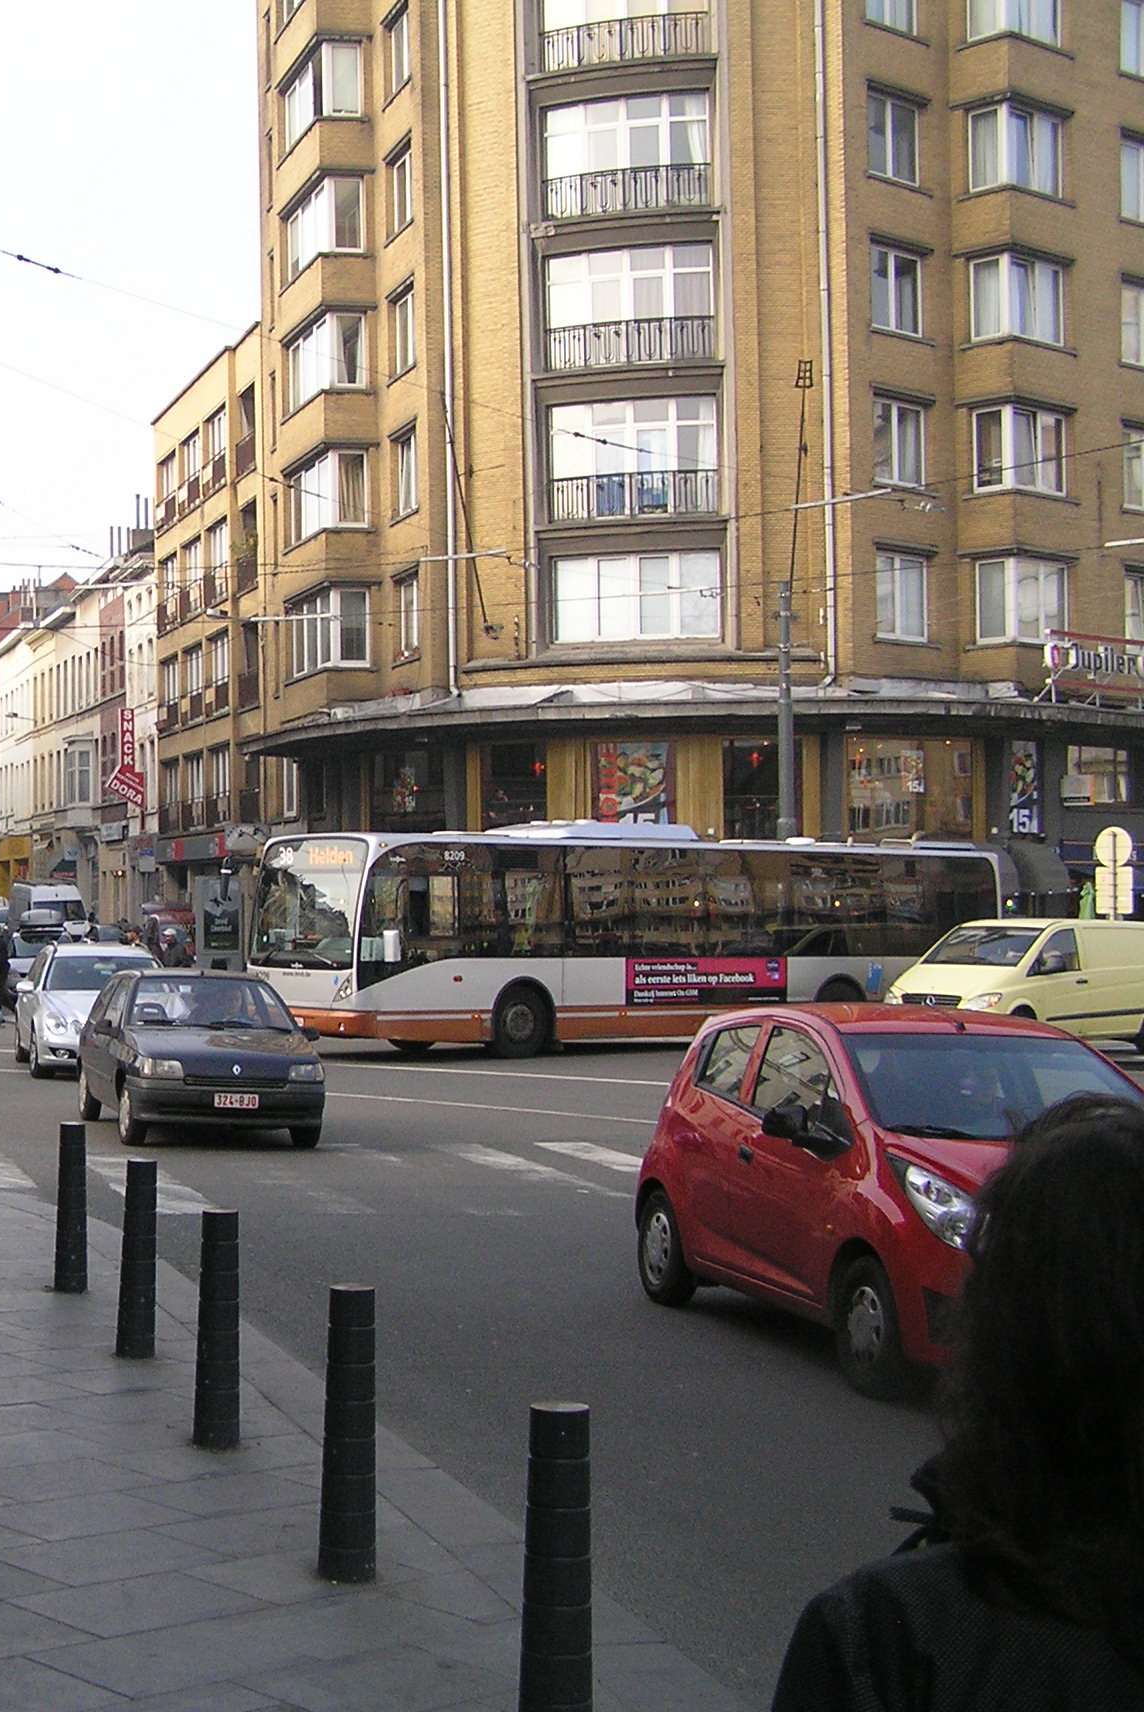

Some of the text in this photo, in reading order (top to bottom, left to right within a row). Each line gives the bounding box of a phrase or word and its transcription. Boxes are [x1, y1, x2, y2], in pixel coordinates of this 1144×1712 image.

[1069, 643, 1137, 676] Jupiler
[123, 709, 133, 765] SNACK
[110, 779, 143, 805] DORA
[279, 845, 353, 865] 38 Helden
[444, 850, 465, 861] 8209
[634, 973, 754, 985] als eerste iets liken op Facebook
